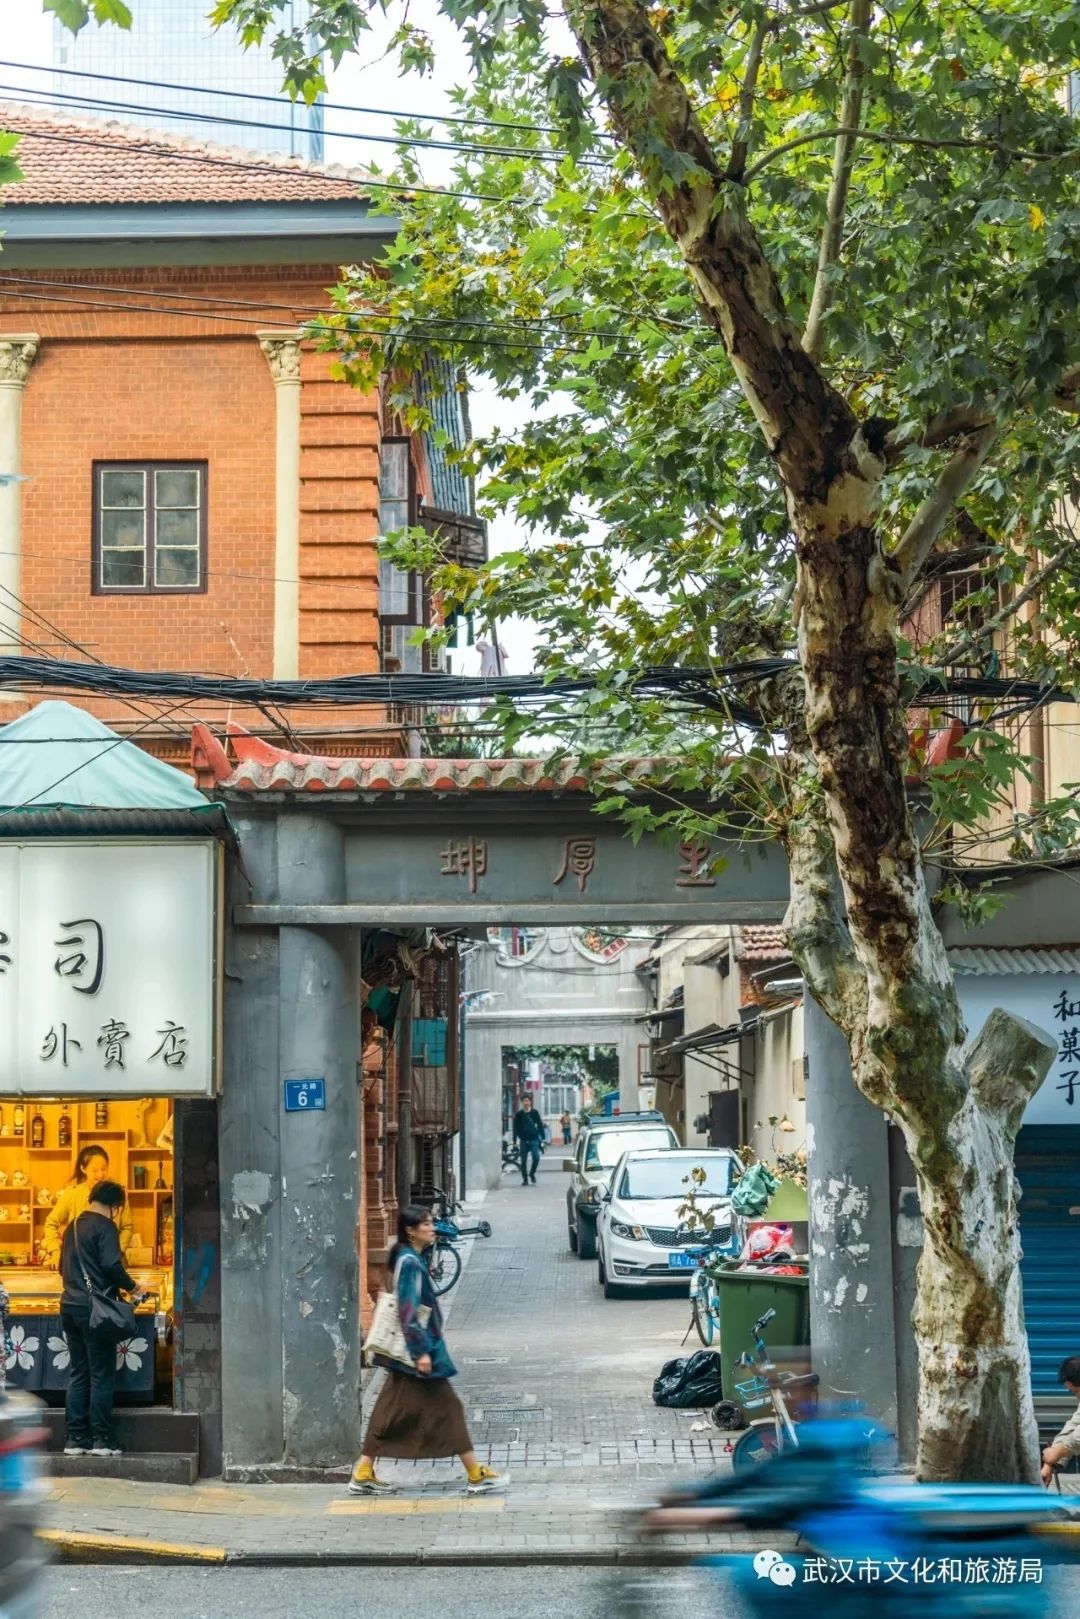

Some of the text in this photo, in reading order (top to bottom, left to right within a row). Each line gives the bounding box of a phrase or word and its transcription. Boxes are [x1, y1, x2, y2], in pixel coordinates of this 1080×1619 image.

[440, 836, 717, 894] 坤厚里
[40, 1018, 188, 1069] 外賣店
[1053, 989, 1080, 1106] 和菓子
[297, 1091, 308, 1107] 6
